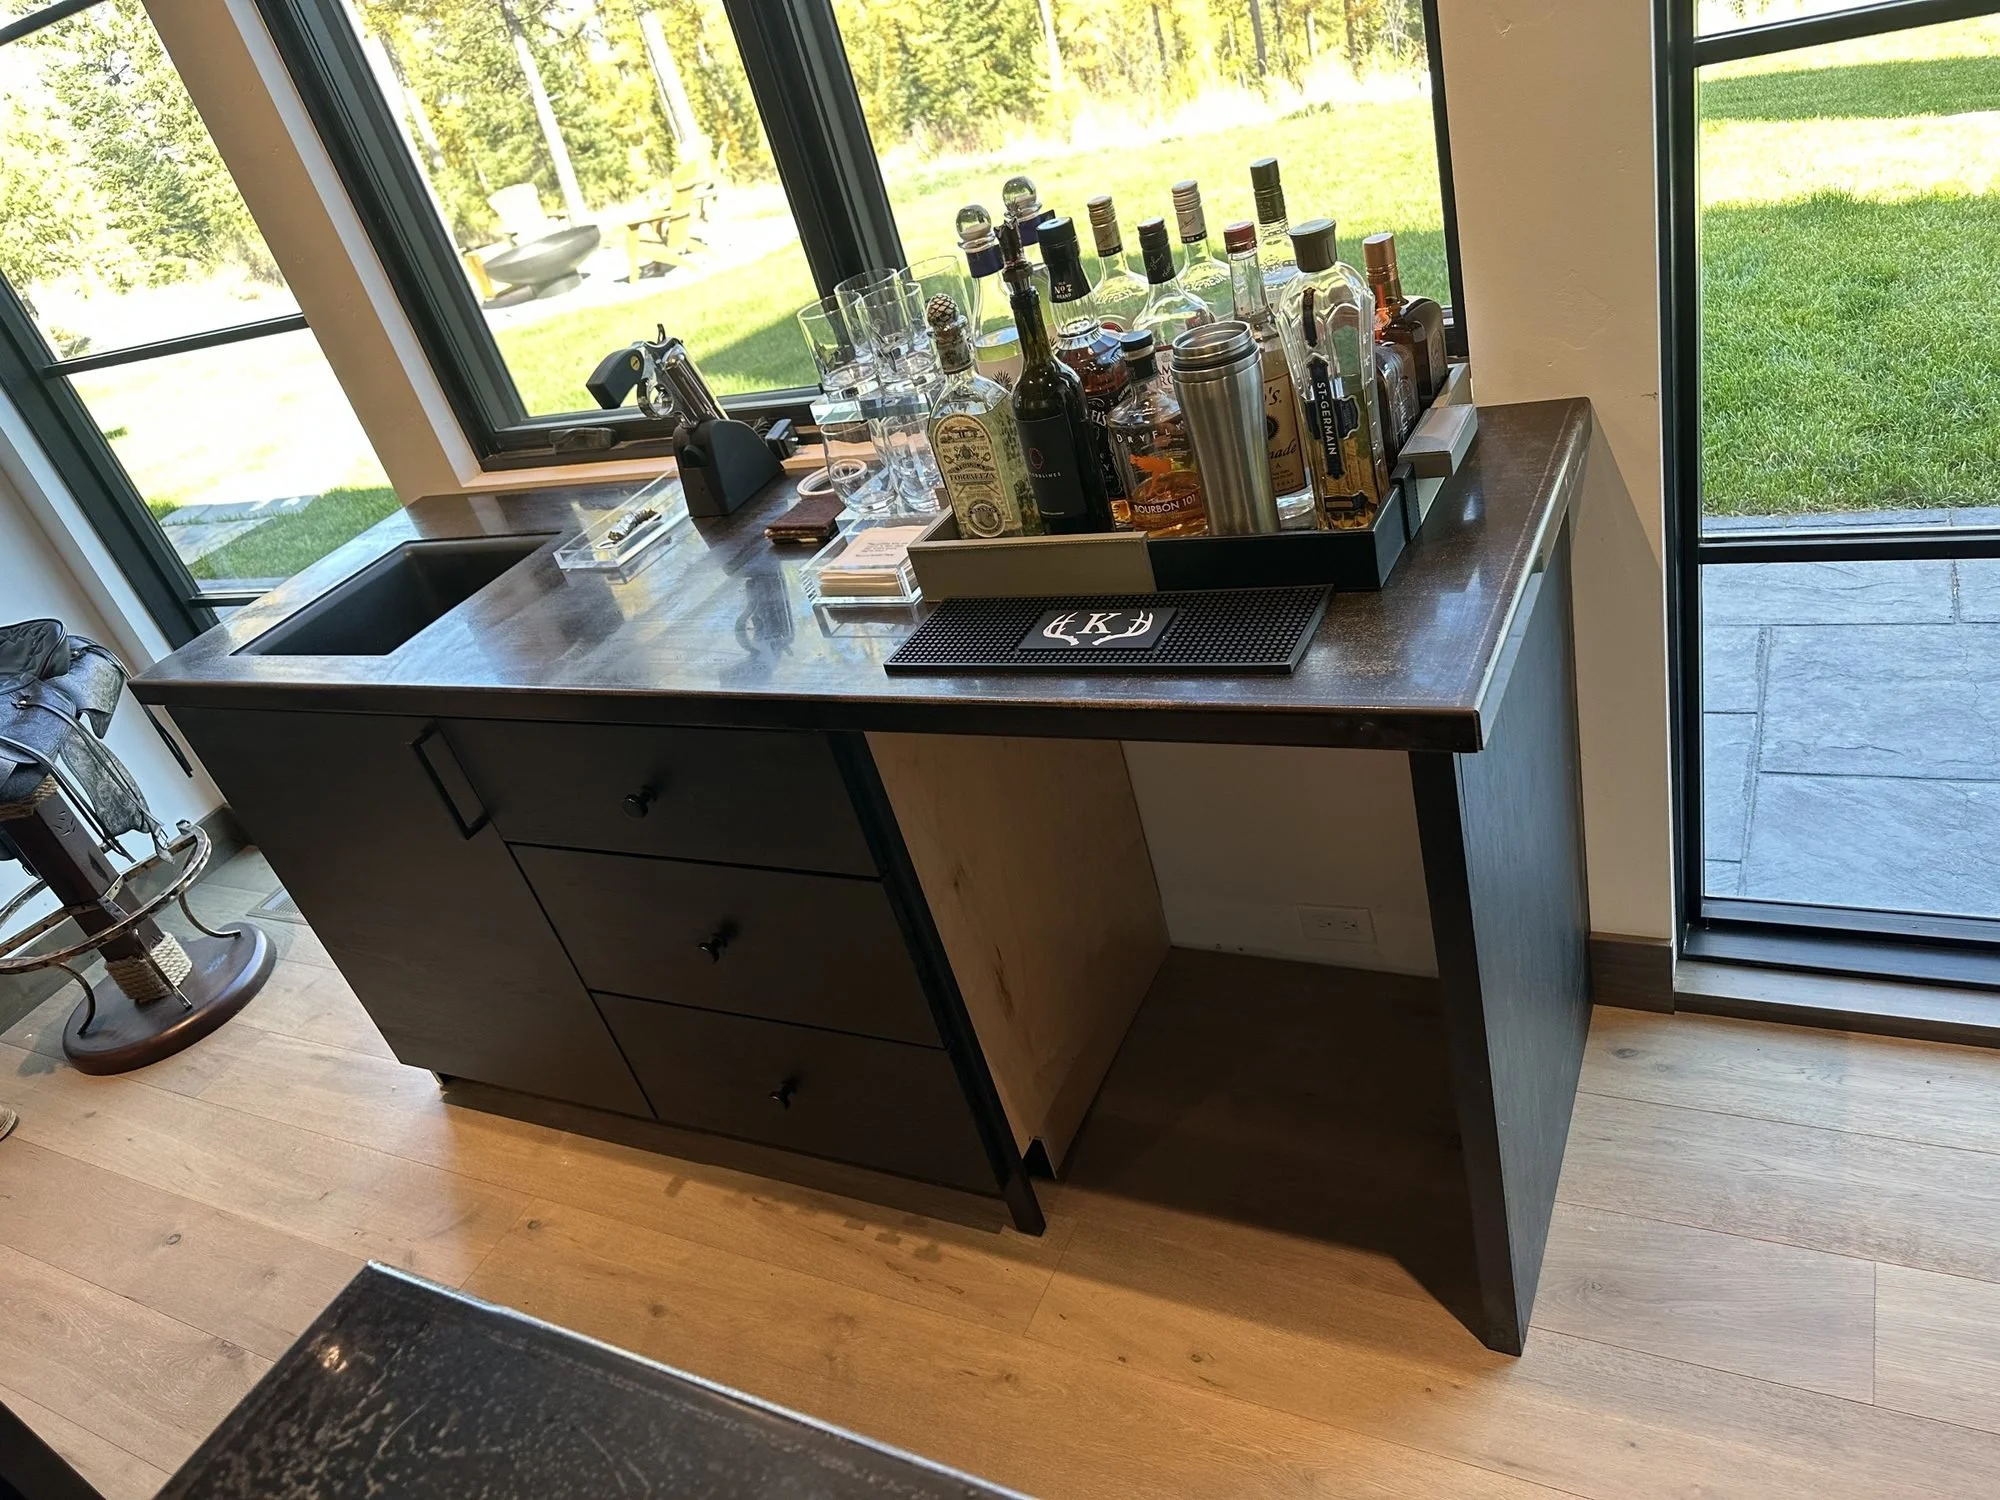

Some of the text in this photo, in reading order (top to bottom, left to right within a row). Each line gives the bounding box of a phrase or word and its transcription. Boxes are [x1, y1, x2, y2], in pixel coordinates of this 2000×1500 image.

[1316, 382, 1338, 455] ST-GERMAIN
[1134, 500, 1180, 514] BOURBON
[1183, 493, 1197, 506] 101
[1075, 612, 1122, 634] K
